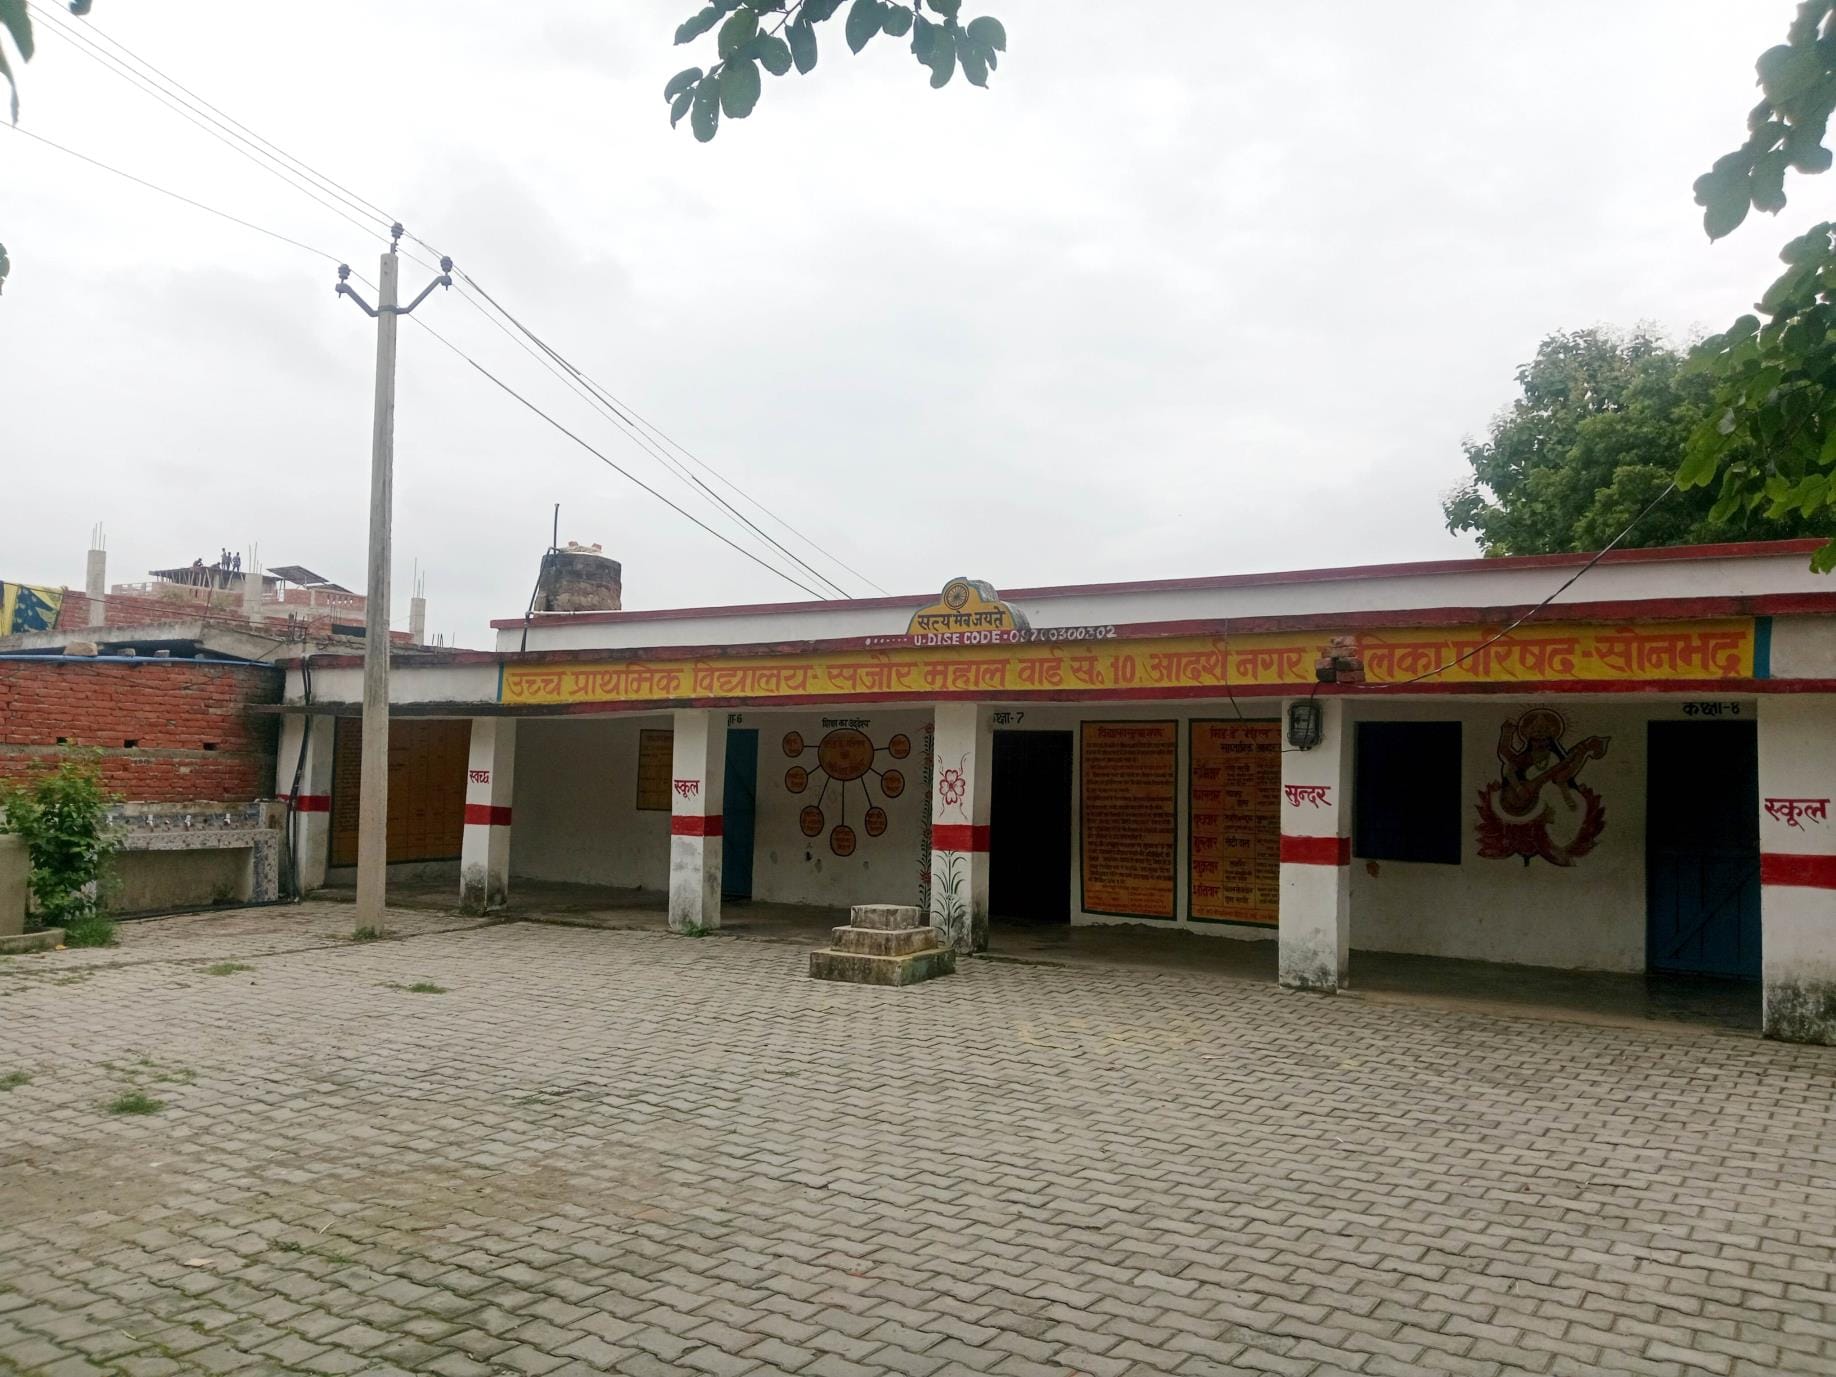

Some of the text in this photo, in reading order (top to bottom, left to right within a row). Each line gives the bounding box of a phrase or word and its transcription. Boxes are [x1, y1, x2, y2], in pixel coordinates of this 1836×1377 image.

[974, 606, 1006, 631] जयते
[506, 671, 567, 698] उच्च
[568, 662, 683, 696] प्राथमिक
[1235, 649, 1308, 682] नगर
[674, 780, 700, 800] स्कूल
[1284, 785, 1332, 808] सुन्दर
[1764, 798, 1830, 832] स्कूल
